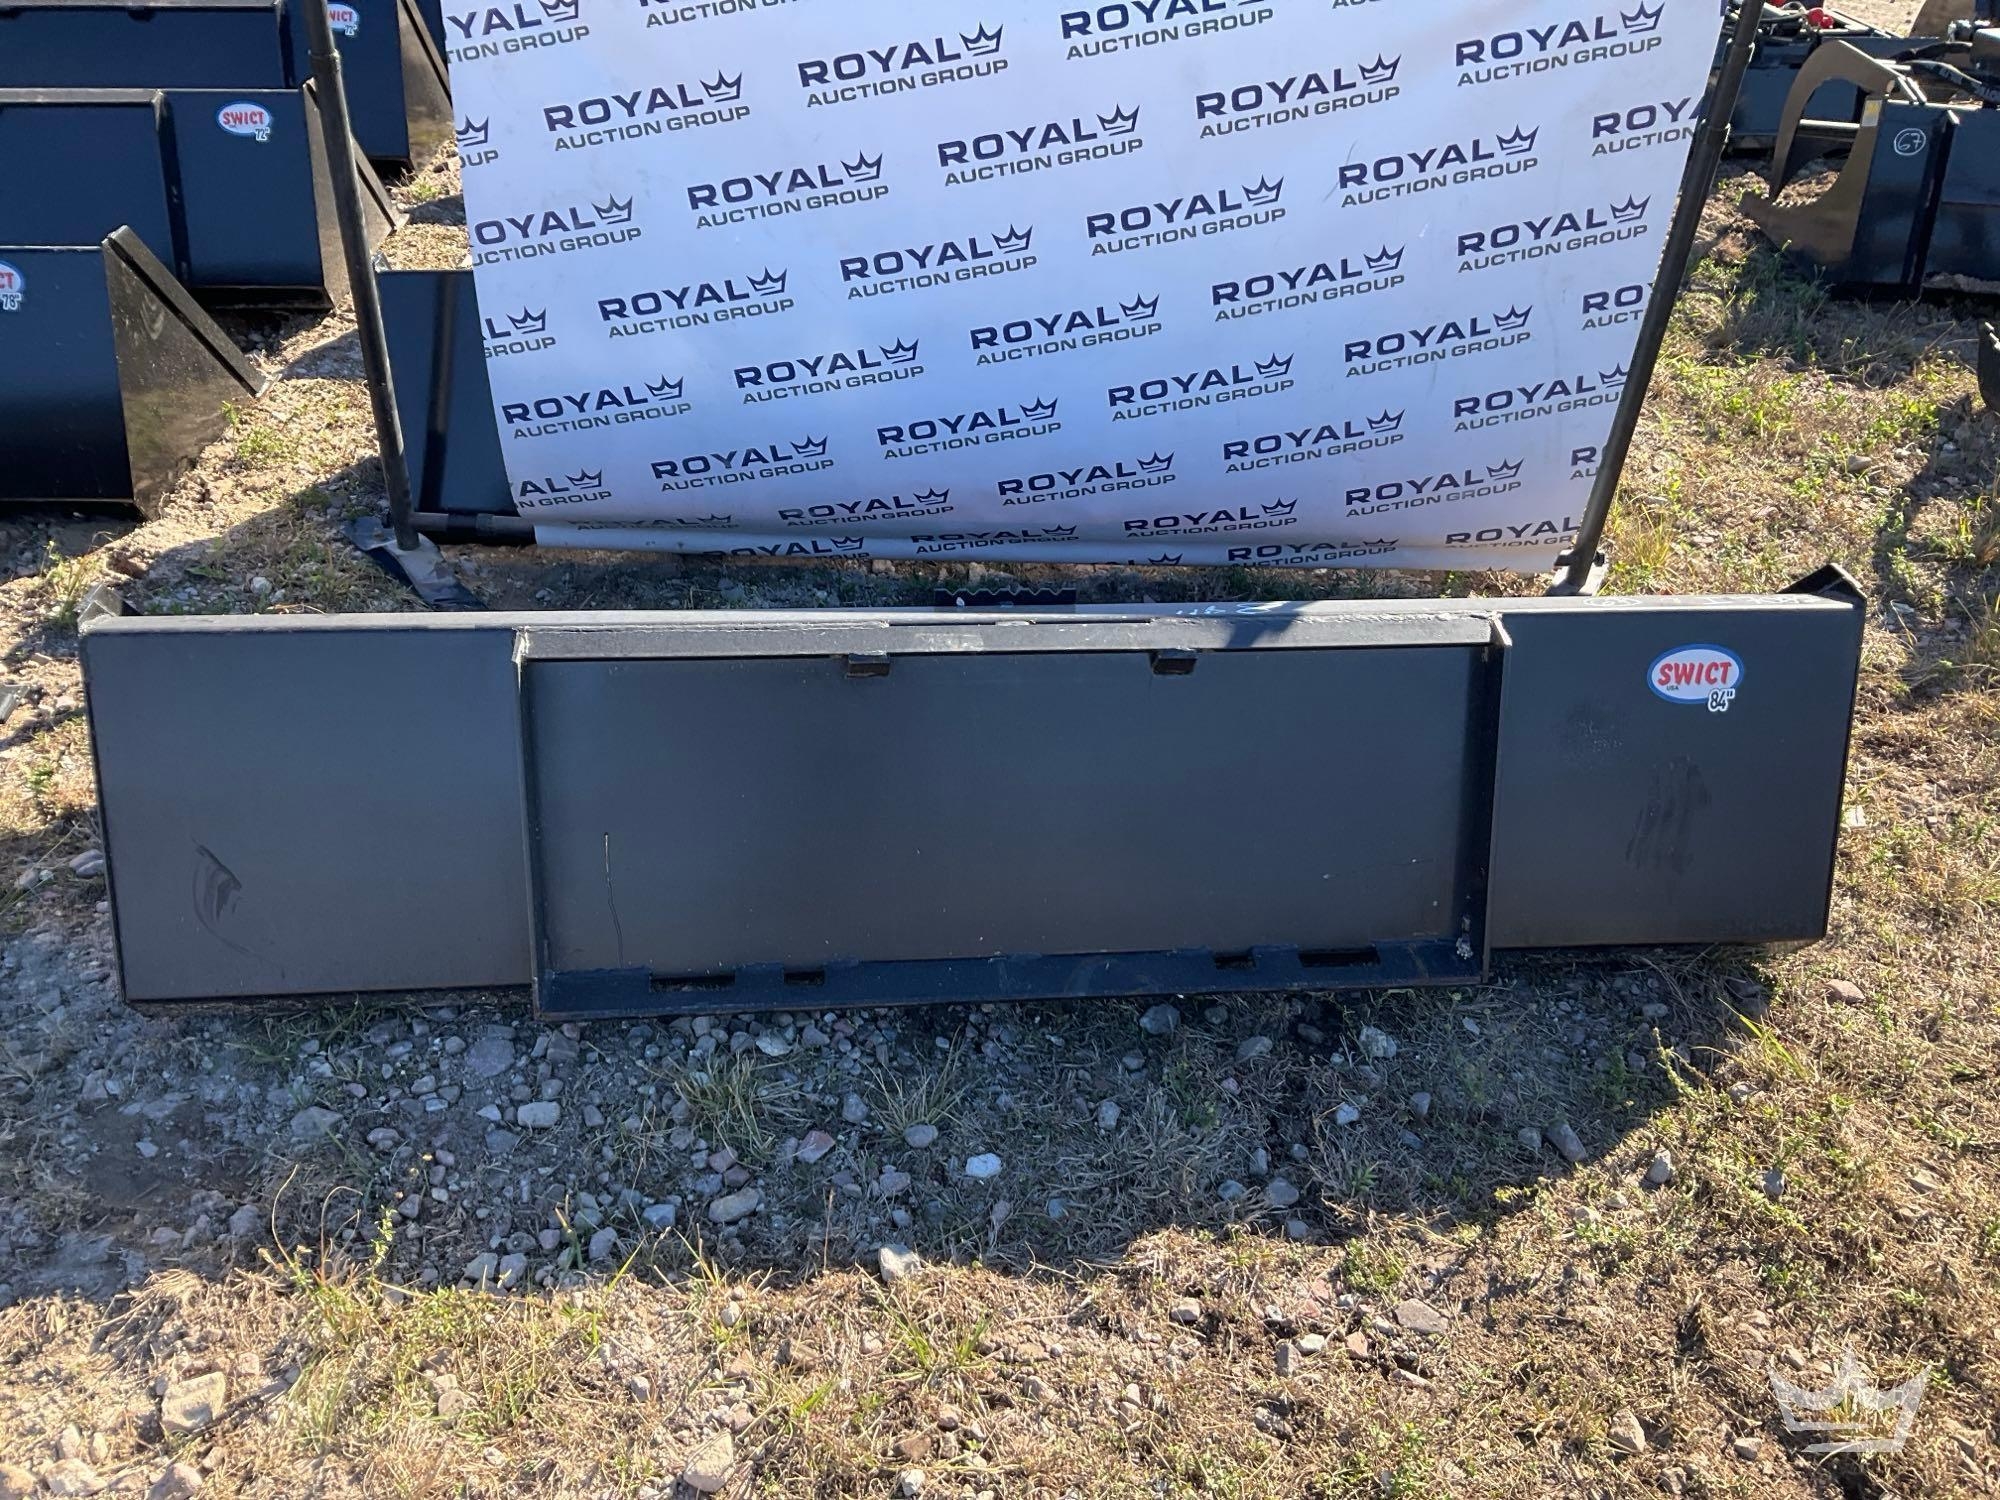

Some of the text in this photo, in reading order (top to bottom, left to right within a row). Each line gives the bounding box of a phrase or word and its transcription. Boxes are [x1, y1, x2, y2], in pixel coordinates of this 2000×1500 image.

[444, 3, 543, 39] YAL
[502, 25, 591, 54] GROUP
[1066, 7, 1274, 61] AUCTION GROUP
[1455, 15, 1618, 68] ROYAL
[797, 36, 962, 89] ROYAL
[1456, 35, 1663, 88] AUCTION GROUP
[806, 58, 1009, 108] AUCTION GROUP
[1195, 67, 1358, 120] ROYAL
[222, 110, 265, 125] SWICT
[542, 83, 705, 133] ROYAL
[554, 105, 751, 152] AUCTION GROUP
[1199, 85, 1401, 140] AUCTION GROUP
[937, 117, 1099, 168] ROYAL
[944, 137, 1144, 187] AUCTION GROUP
[1338, 138, 1496, 190] ROYAL
[1340, 157, 1539, 209] AUCTION GROUP
[686, 164, 845, 211] ROYAL
[695, 184, 890, 230] AUCTION GROUP
[472, 206, 597, 246] OYAL
[1086, 188, 1243, 239] ROYAL
[1090, 207, 1287, 257] AUCTION GROUP
[1457, 207, 1608, 257] ROYAL
[558, 227, 642, 252] GROUP
[839, 236, 994, 283] ROYAL
[1457, 224, 1648, 274] AUCTION GROUP
[847, 255, 1038, 301] AUCTION GROUP
[1211, 257, 1364, 307] ROYAL
[1214, 274, 1405, 323] AUCTION GROUP
[597, 279, 751, 322] ROYAL
[608, 297, 795, 339] AUCTION GROUP
[969, 305, 1121, 352] ROYAL
[975, 322, 1163, 367] AUCTION GROUP
[1344, 316, 1492, 364] ROYAL
[734, 348, 884, 389] ROYAL
[1345, 331, 1531, 379] AUCTION GROUP
[500, 385, 649, 425] ROYAL
[743, 365, 925, 404] AUCTION GROUP
[1107, 364, 1255, 408] ROYAL
[1111, 379, 1295, 423] AUCTION GROUP
[1453, 374, 1597, 419] ROYAL
[513, 402, 692, 440] AUCTION GROUP
[876, 407, 1021, 447] ROYAL
[1454, 404, 1553, 433] AUCTION
[883, 421, 1062, 460] AUCTION GROUP
[1223, 420, 1366, 461] ROYAL
[1224, 433, 1405, 474] AUCTION GROUP
[650, 444, 794, 480] ROYAL
[661, 458, 835, 493] AUCTION GROUP
[997, 461, 1138, 497] ROYAL
[538, 490, 613, 506] GROUP
[777, 495, 915, 521] ROYAL
[1002, 473, 1177, 507] AUCTION GROUP
[1345, 468, 1485, 507] ROYAL
[1345, 480, 1522, 518] AUCTION GROUP
[786, 505, 955, 527] AUCTION GROUP
[910, 529, 1042, 544] ROYAL
[1123, 506, 1261, 532] ROYAL
[1126, 517, 1298, 538] AUCTION GROUP
[1444, 517, 1581, 545] ROYAL
[916, 538, 1004, 554] AUCTION
[1226, 541, 1361, 562] ROYAL
[1324, 546, 1397, 561] GROUP
[1657, 661, 1732, 686] SWICT
[1709, 689, 1734, 711] 84"
